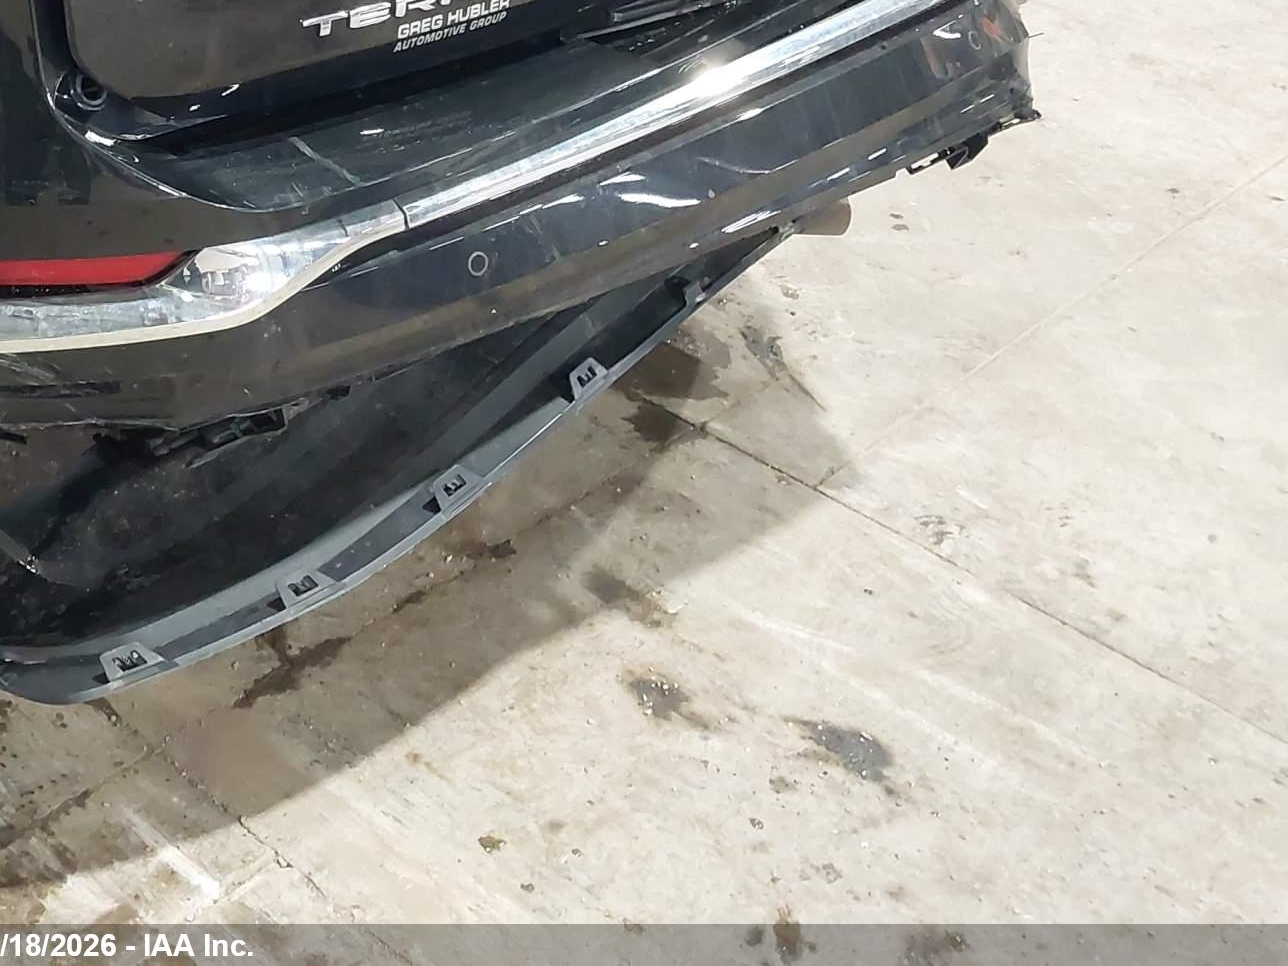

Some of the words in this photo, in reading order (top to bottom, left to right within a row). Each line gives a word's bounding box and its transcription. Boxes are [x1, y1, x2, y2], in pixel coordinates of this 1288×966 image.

[393, 23, 467, 53] AUTOMOTIVE
[469, 11, 508, 32] GROUP
[397, 14, 444, 40] GREG
